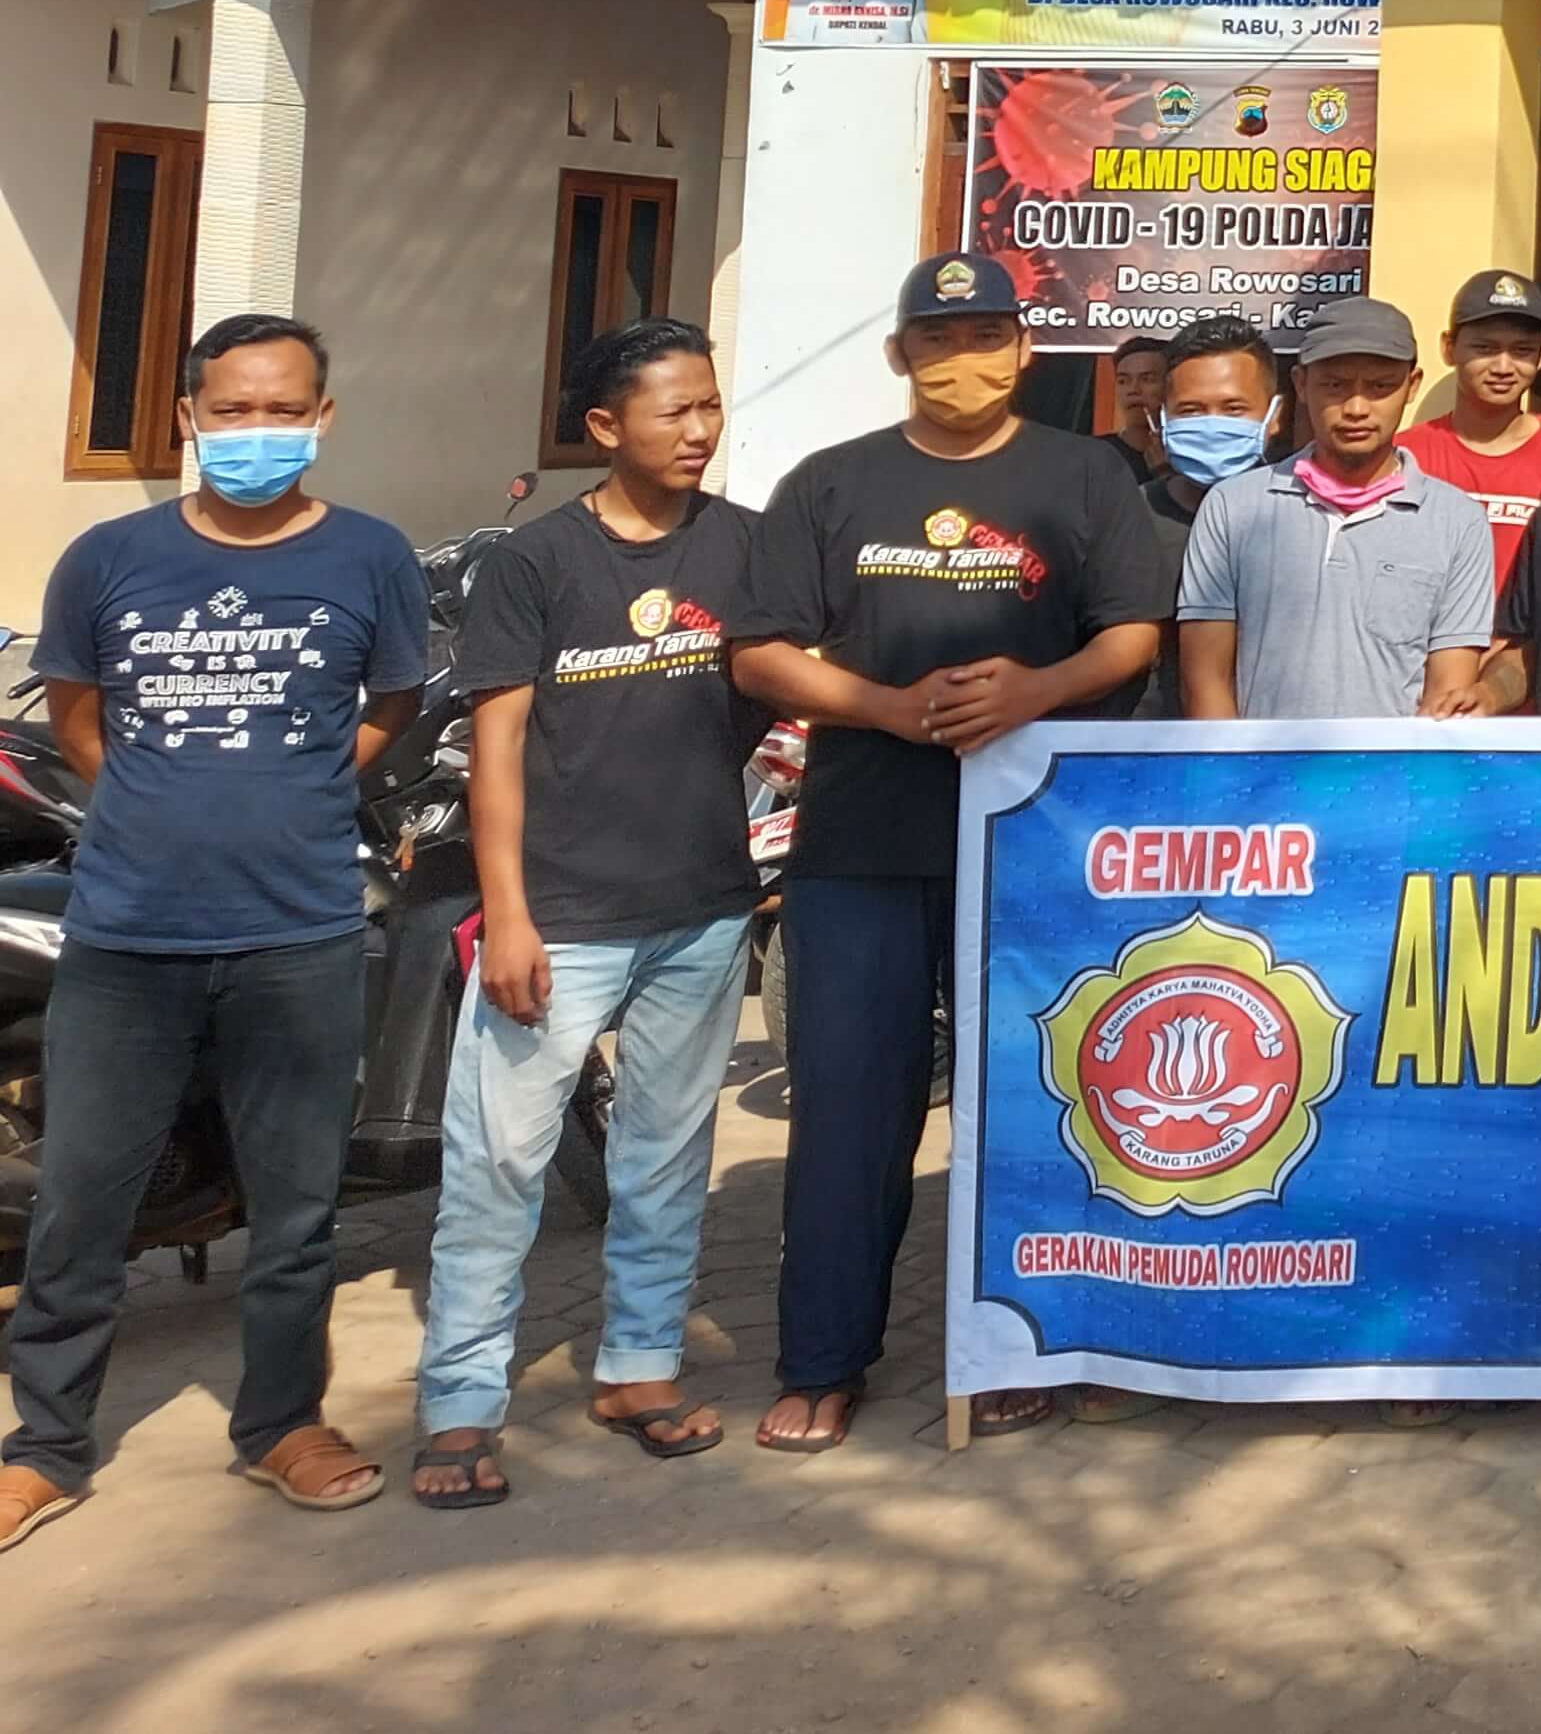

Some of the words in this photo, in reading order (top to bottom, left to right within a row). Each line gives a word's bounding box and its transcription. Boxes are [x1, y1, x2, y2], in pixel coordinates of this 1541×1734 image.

[1222, 19, 1285, 39] RABU,
[1292, 19, 1304, 36] 3
[1310, 19, 1361, 36] JUNI
[1093, 147, 1277, 192] KAMPUNG
[1287, 147, 1375, 193] SIAG
[1015, 203, 1134, 249] COVID
[1160, 202, 1205, 248] 19
[1213, 204, 1330, 249] POLDA
[1335, 204, 1372, 249] JA
[1117, 267, 1199, 293] Desa
[1210, 267, 1362, 293] Rowosari
[856, 543, 941, 569] Karang
[948, 547, 1025, 568] Taruna
[129, 627, 311, 654] CREATIVITY
[206, 655, 227, 671] IS
[555, 642, 651, 671] Karang
[137, 671, 292, 695] CURRENCY
[139, 695, 177, 708] WITH
[179, 694, 204, 707] NO
[205, 693, 285, 707] INFLATION
[1086, 824, 1315, 898] GEMPAR
[1106, 997, 1147, 1036] ADHITYA
[1148, 981, 1188, 999] KARYA
[1191, 980, 1244, 1001] MAHATVA
[1244, 997, 1274, 1032] YODHA
[1126, 1140, 1181, 1167] KARANG
[1186, 1138, 1240, 1166] TARUNA
[1015, 1233, 1123, 1282] GERAKAN
[1126, 1240, 1219, 1287] PEMUDA
[1224, 1239, 1356, 1286] ROWOSARI
